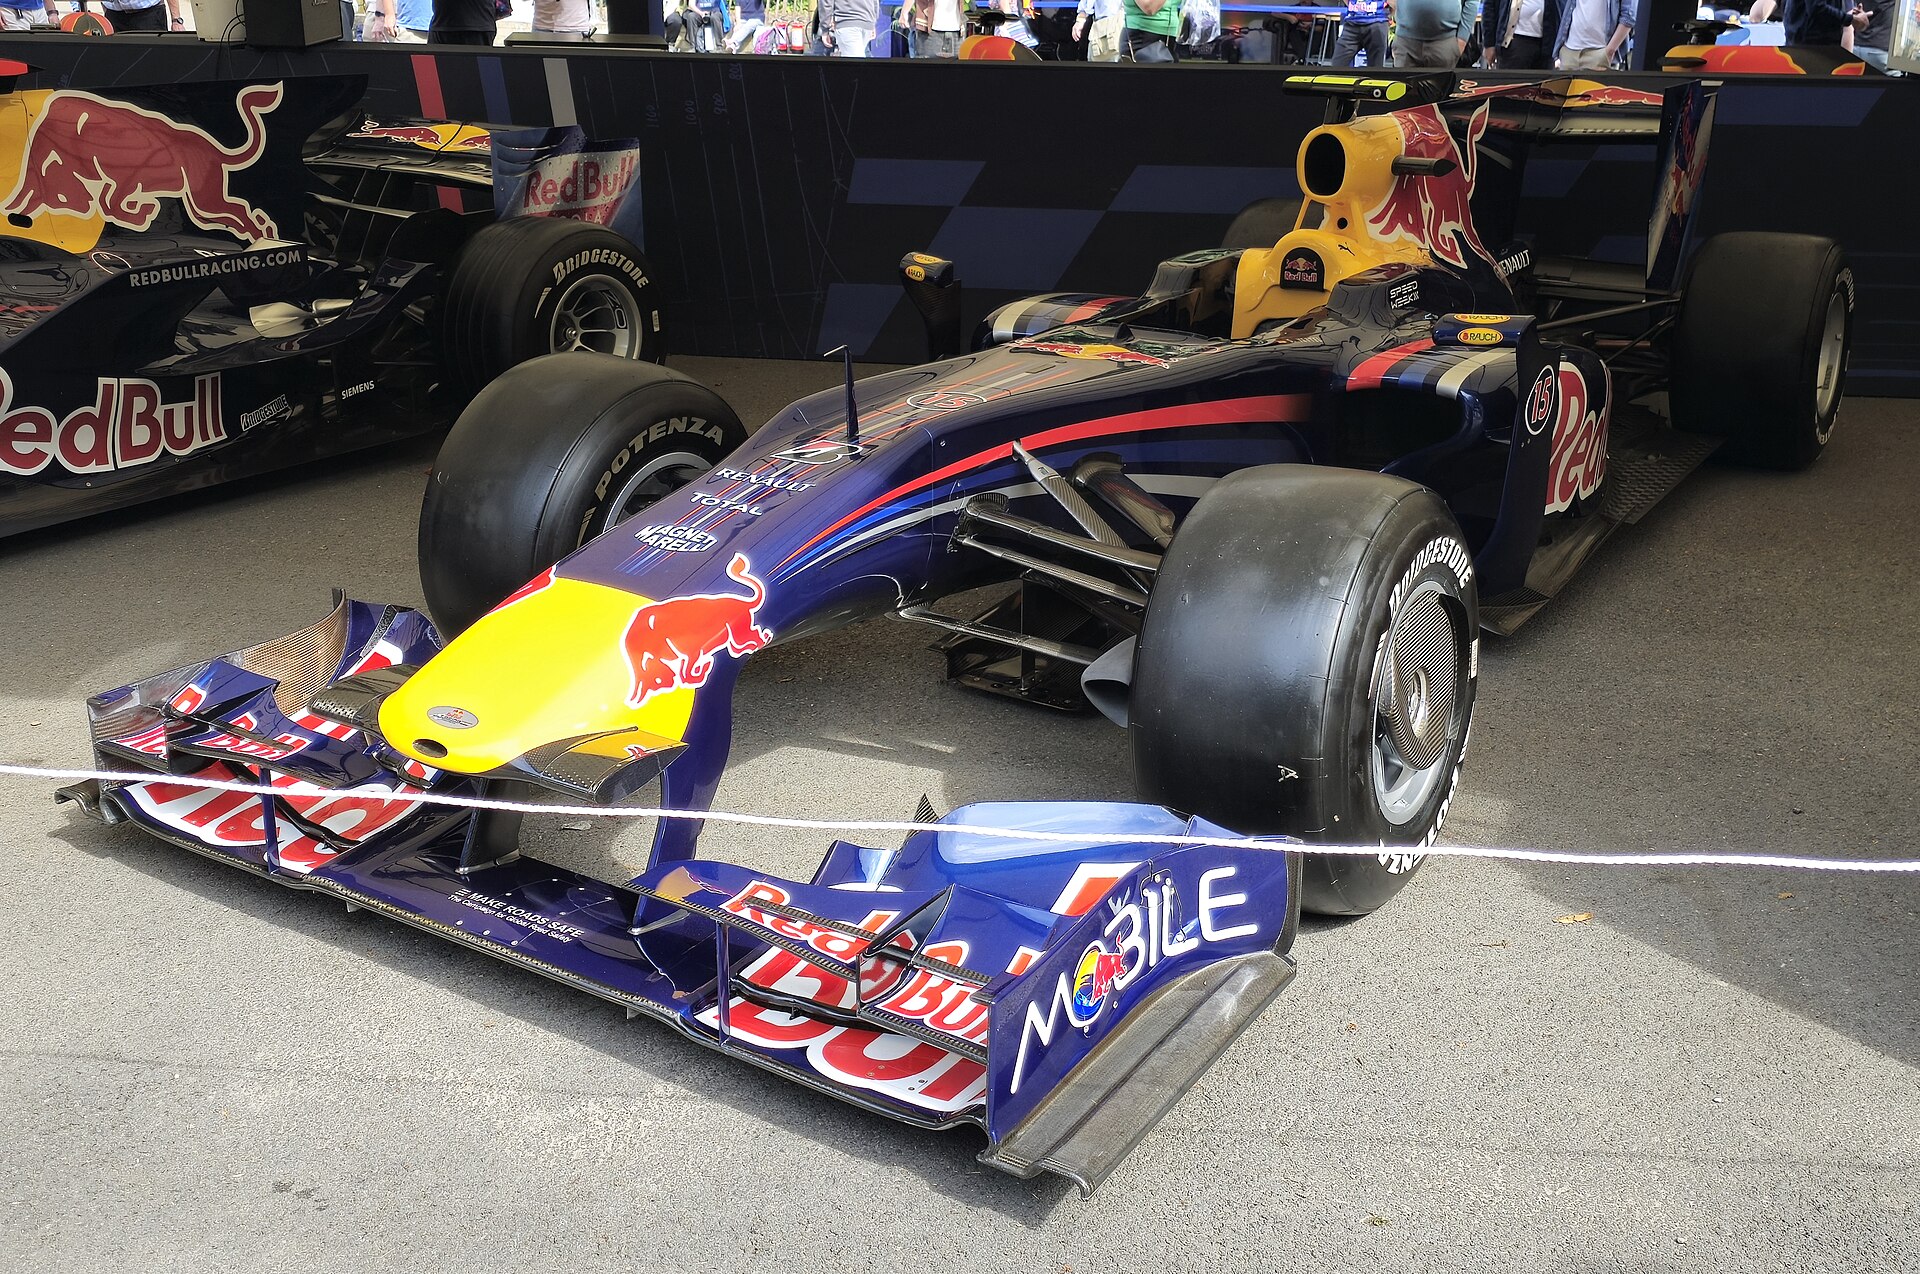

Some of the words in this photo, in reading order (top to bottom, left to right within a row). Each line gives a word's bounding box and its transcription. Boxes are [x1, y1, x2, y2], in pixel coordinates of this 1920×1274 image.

[523, 160, 579, 208] Red
[583, 155, 634, 200] Bull
[129, 249, 301, 287] REDBULLRACING.COM
[552, 248, 649, 288] BRIDGESTONE
[1390, 280, 1418, 299] SPEED
[1469, 332, 1498, 341] RAUCH
[341, 380, 375, 400] SIEMENS
[1531, 376, 1552, 424] 15
[117, 372, 228, 469] Bull
[240, 394, 290, 431] BRIDGESTONE
[595, 416, 724, 502] POTENZA
[714, 467, 817, 493] RENAULT
[690, 491, 763, 516] TOTAL
[1389, 536, 1473, 619] BRIDGESTONE
[448, 894, 461, 905] The
[461, 899, 496, 917] Campaign
[494, 910, 507, 920] for
[506, 915, 530, 929] Global
[528, 923, 550, 935] Road
[548, 929, 574, 944] Safety
[467, 891, 507, 910] MAKE
[503, 905, 550, 926] ROADS
[548, 920, 585, 938] SAFE
[868, 940, 990, 1046] Bul
